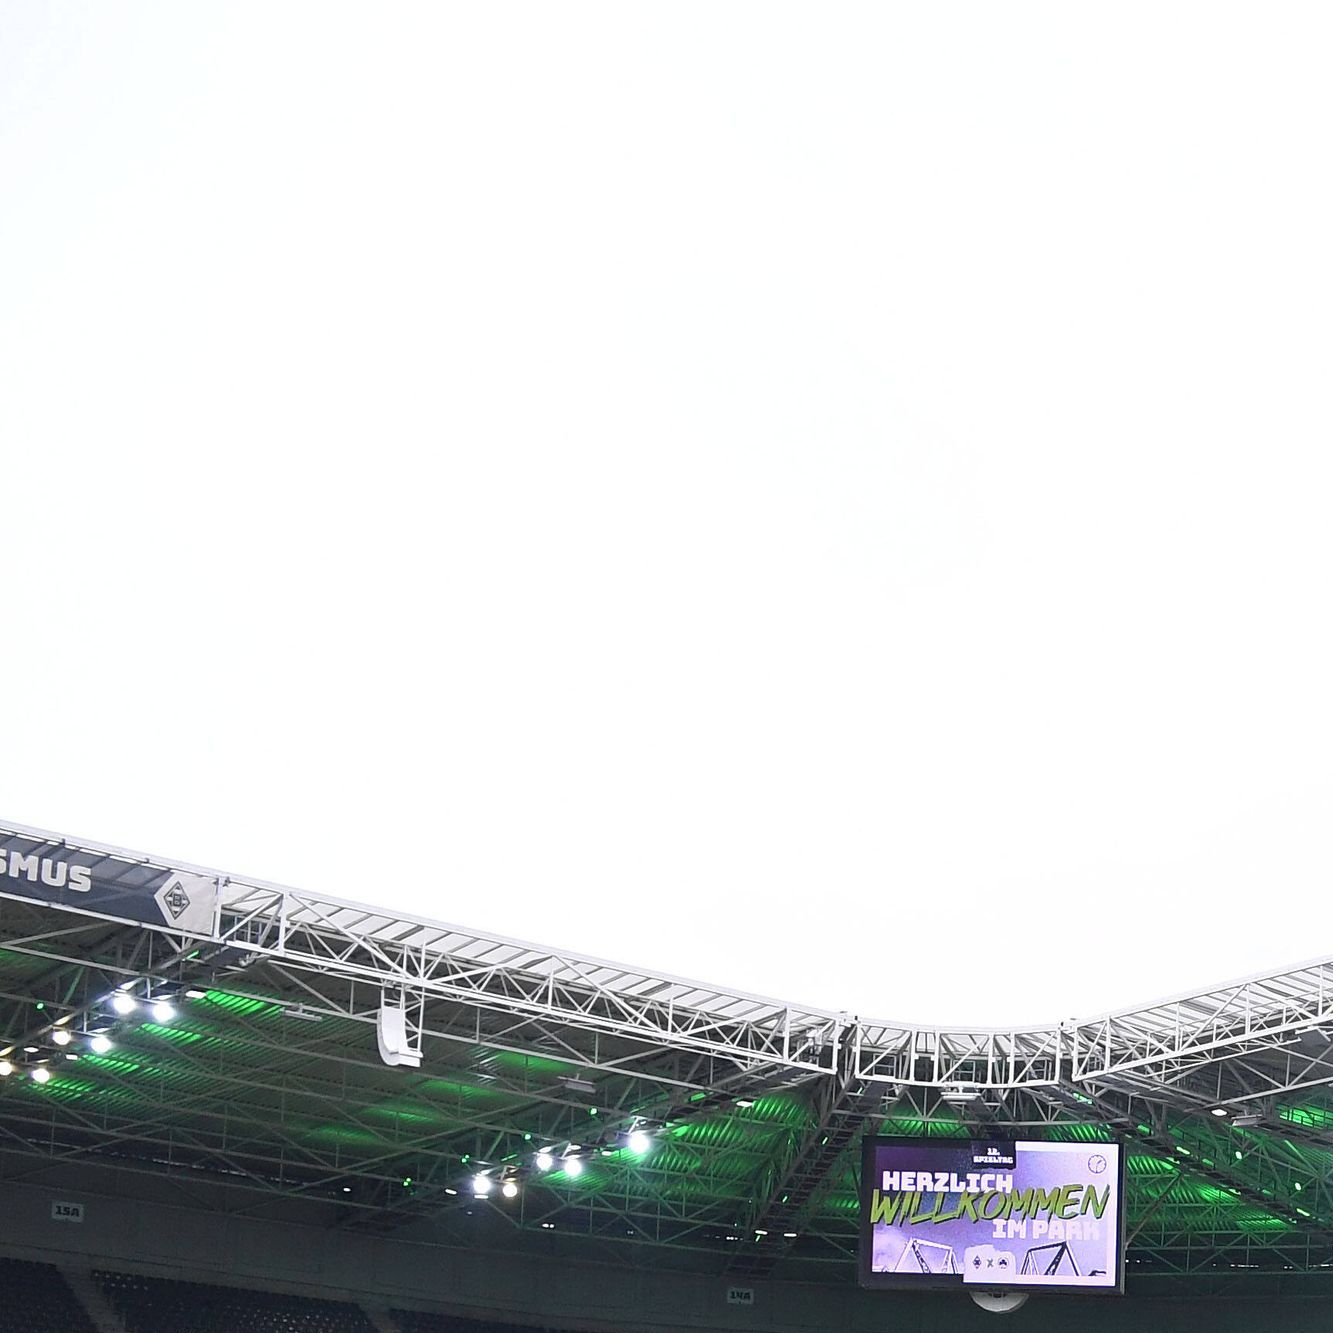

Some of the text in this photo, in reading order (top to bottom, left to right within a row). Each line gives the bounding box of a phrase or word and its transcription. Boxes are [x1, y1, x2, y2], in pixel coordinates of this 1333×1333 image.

[882, 1170, 1013, 1194] HERZLICH
[870, 1183, 1110, 1227] WILLKOMMEN
[992, 1219, 1100, 1240] IM PARK
